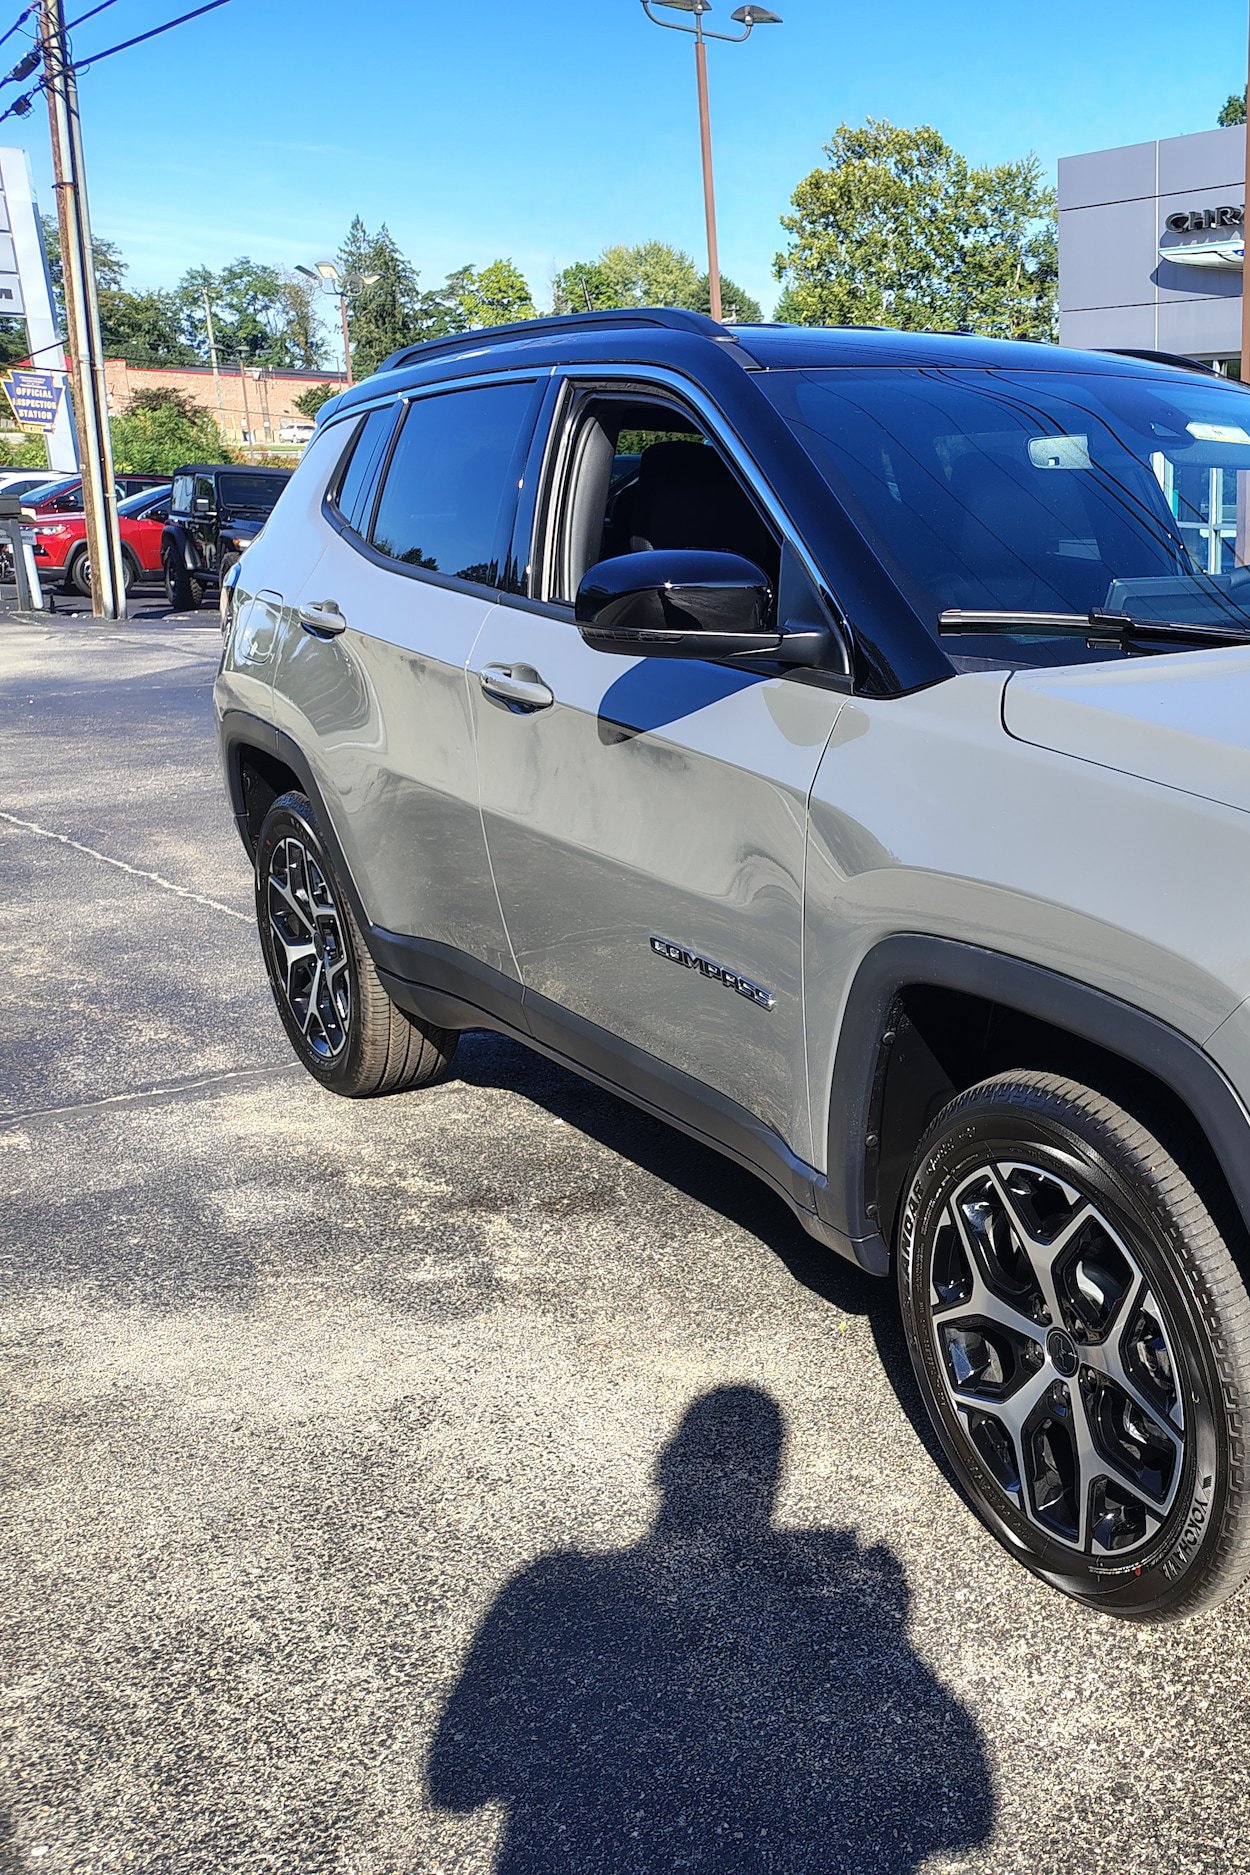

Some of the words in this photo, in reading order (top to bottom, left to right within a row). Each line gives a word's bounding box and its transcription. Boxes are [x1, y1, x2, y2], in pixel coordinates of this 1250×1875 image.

[15, 386, 54, 399] OFFICIAL
[19, 409, 53, 420] STATION
[650, 935, 775, 1012] COMPASS
